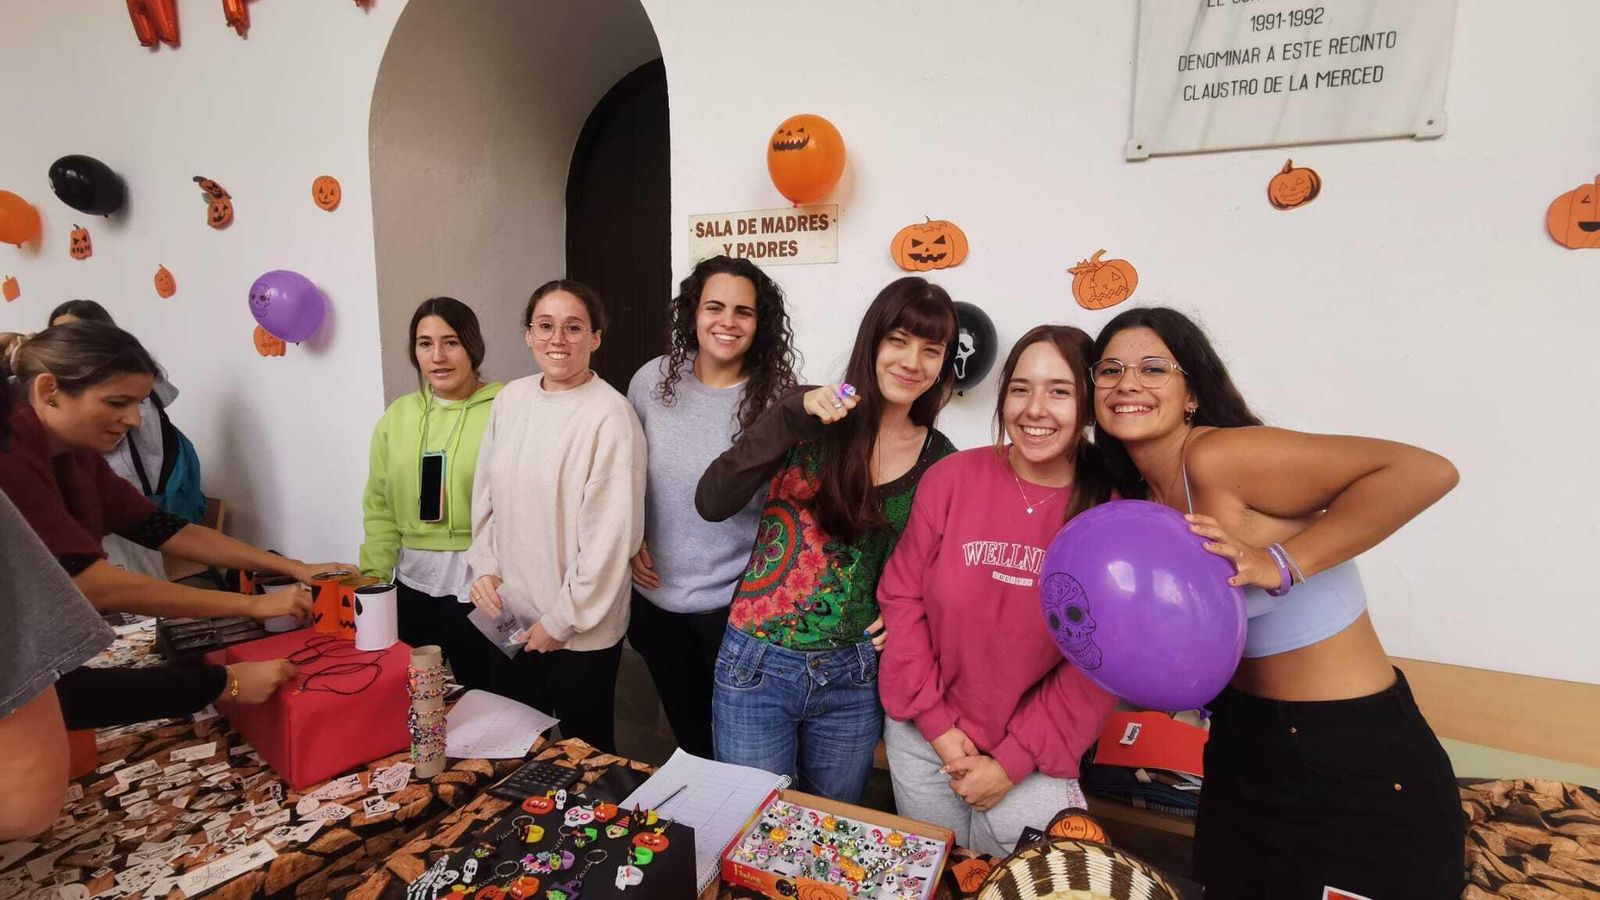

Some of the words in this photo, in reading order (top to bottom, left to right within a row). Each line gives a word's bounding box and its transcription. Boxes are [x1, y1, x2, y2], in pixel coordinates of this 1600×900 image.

[1250, 7, 1325, 32] 1991-1992
[1178, 47, 1261, 72] DENOMINAR
[1266, 46, 1276, 63] A
[1282, 40, 1323, 61] ESTE
[1329, 30, 1398, 56] RECINTO
[1183, 78, 1259, 101] CLAUSTRO
[1264, 76, 1284, 94] DE
[1289, 74, 1308, 92] LA
[1315, 65, 1384, 89] MERCED
[695, 220, 733, 238] SALA
[737, 218, 757, 236] DE
[761, 213, 830, 234] MADRES
[723, 243, 733, 258] Y
[737, 240, 798, 259] PADRES
